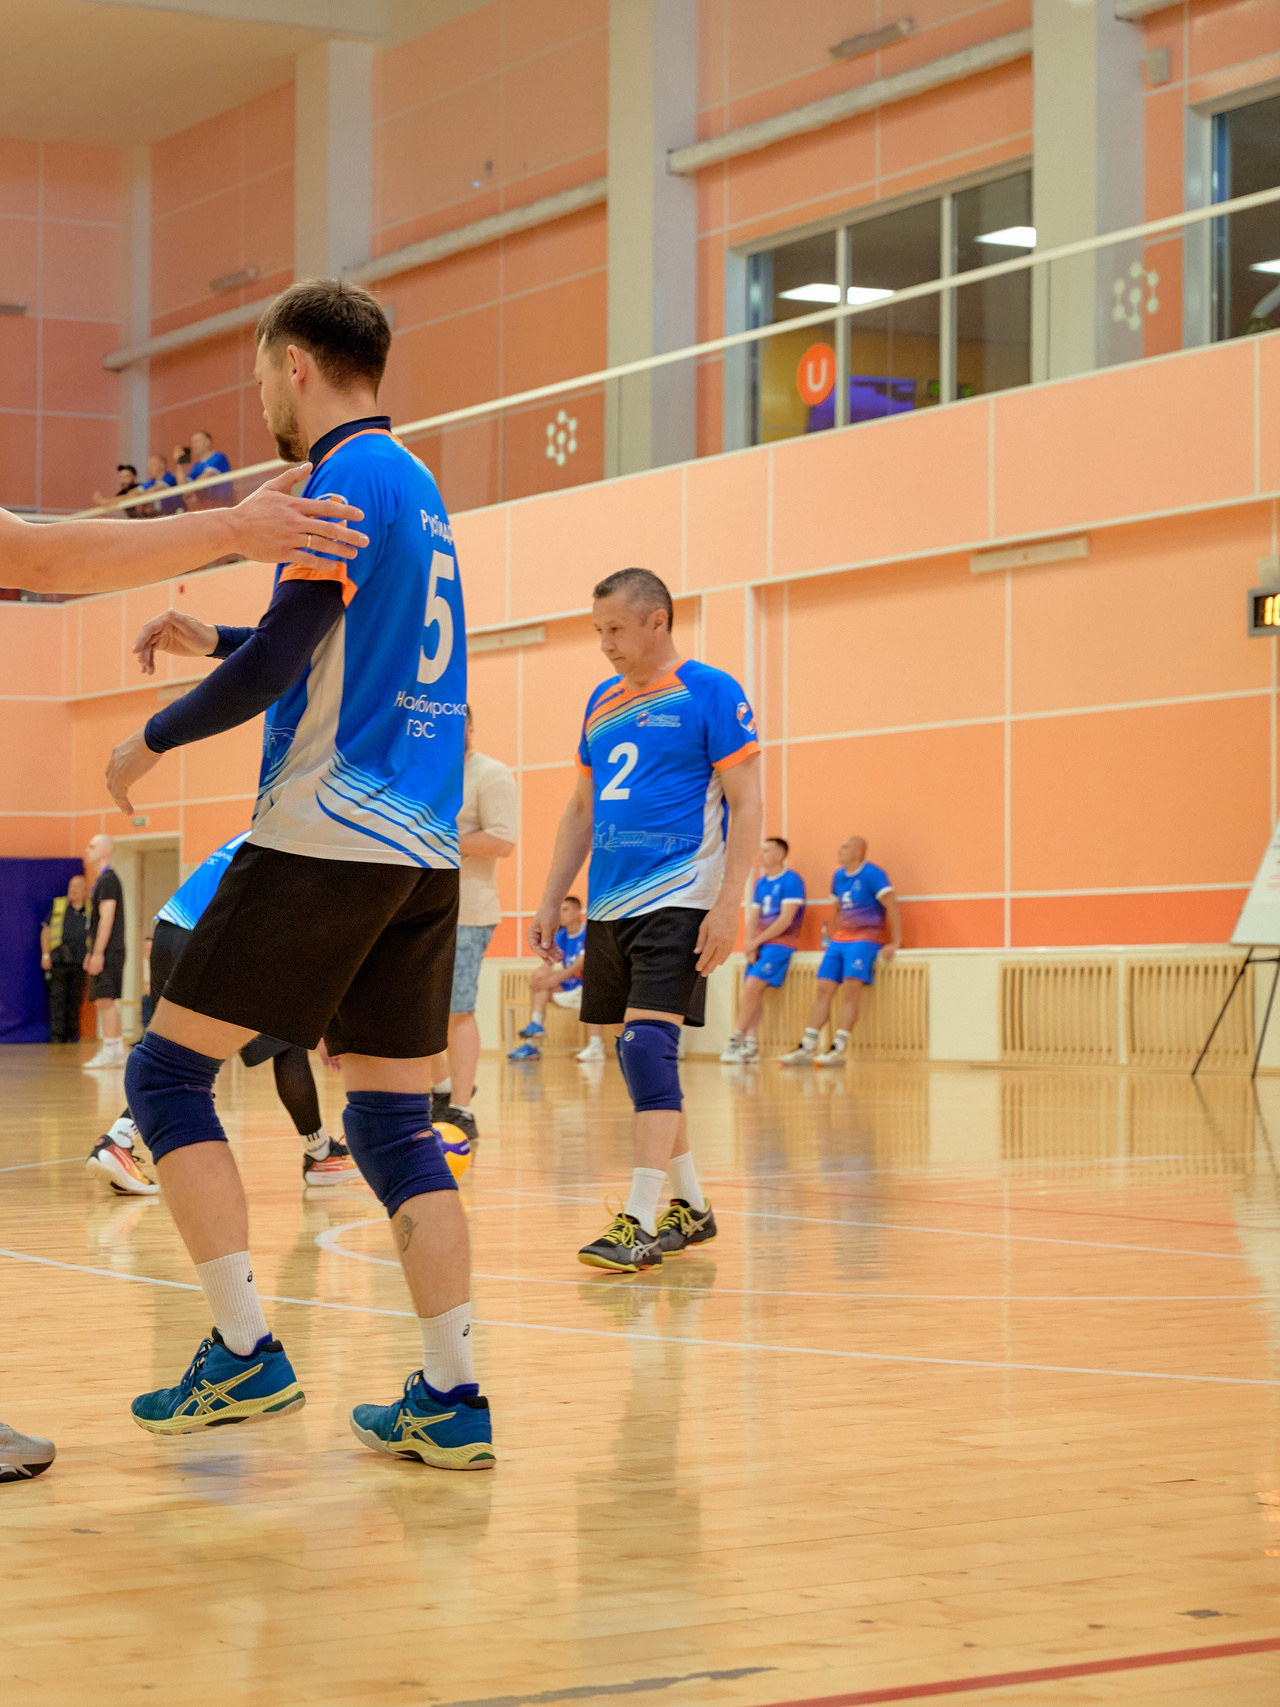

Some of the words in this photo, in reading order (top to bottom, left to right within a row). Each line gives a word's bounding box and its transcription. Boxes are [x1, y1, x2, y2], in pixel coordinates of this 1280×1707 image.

[807, 358, 827, 392] U
[417, 549, 455, 685] 5
[406, 718, 437, 739] ГЭС
[600, 741, 639, 801] 2
